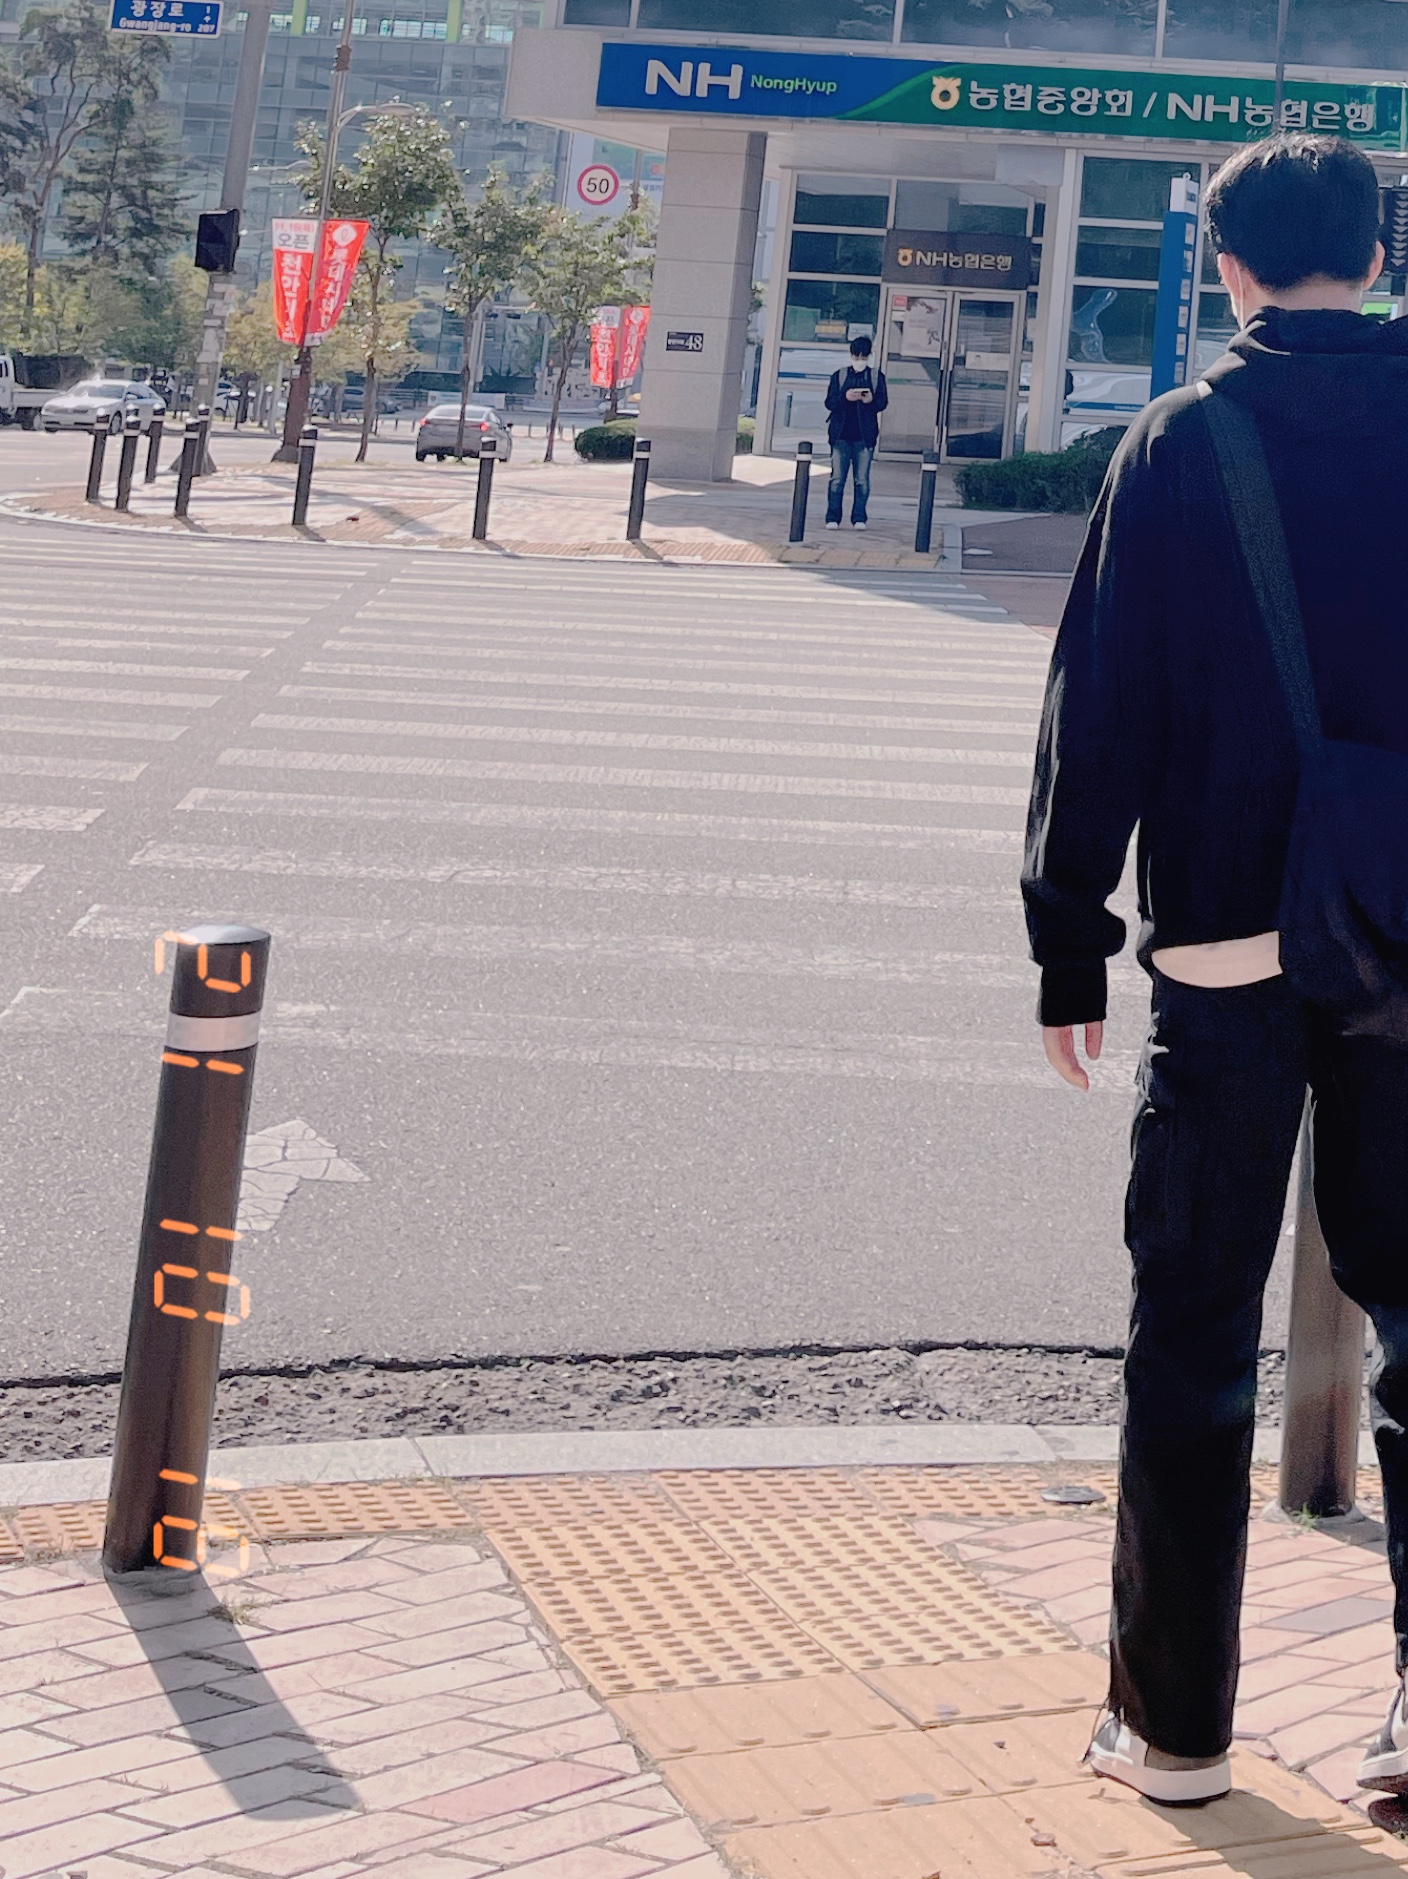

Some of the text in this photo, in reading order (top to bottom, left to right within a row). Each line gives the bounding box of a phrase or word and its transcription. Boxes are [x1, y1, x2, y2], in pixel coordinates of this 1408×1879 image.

[130, 0, 184, 19] 광장로
[644, 58, 838, 100] NH NongHyup
[968, 80, 1134, 118] 농협중앙회
[1166, 91, 1377, 133] NH농협은행
[586, 177, 610, 194] 50
[278, 233, 310, 250] 오픈
[914, 250, 1014, 272] NH농협은행
[684, 334, 703, 350] 48
